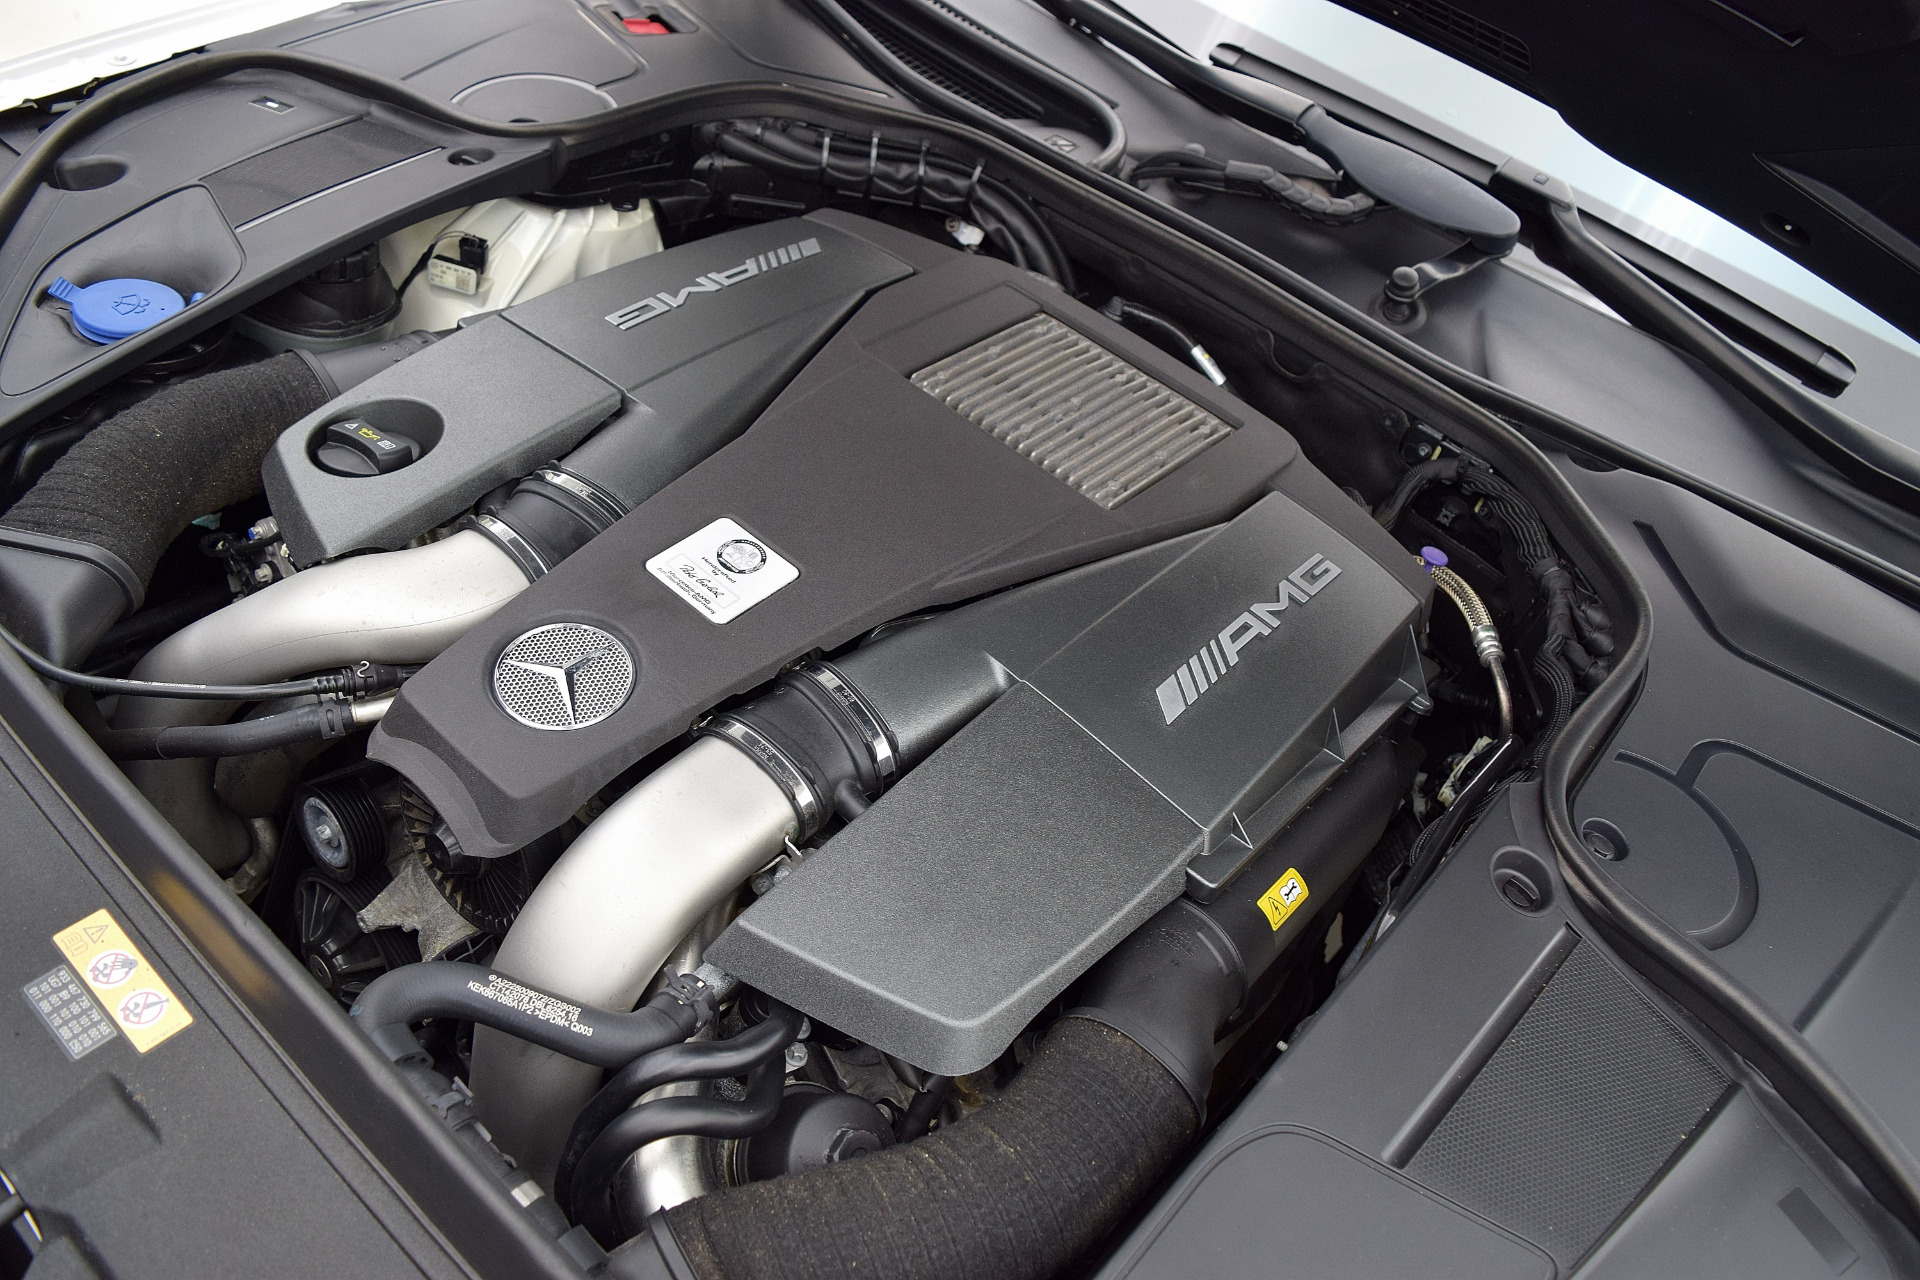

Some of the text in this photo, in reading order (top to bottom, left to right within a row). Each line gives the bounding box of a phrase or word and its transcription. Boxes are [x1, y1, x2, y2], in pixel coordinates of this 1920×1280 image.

[605, 257, 759, 331] AMG
[29, 986, 42, 1000] 011
[39, 1000, 53, 1013] 000
[49, 1013, 62, 1027] 110
[59, 1026, 73, 1040] 000
[39, 981, 92, 1047] 101 001 101 010 010
[68, 983, 81, 995] 467
[77, 995, 91, 1009] 730
[68, 1001, 81, 1015] 100
[79, 1014, 91, 1028] 101
[88, 1027, 102, 1040] 001
[571, 1021, 594, 1037] Q003
